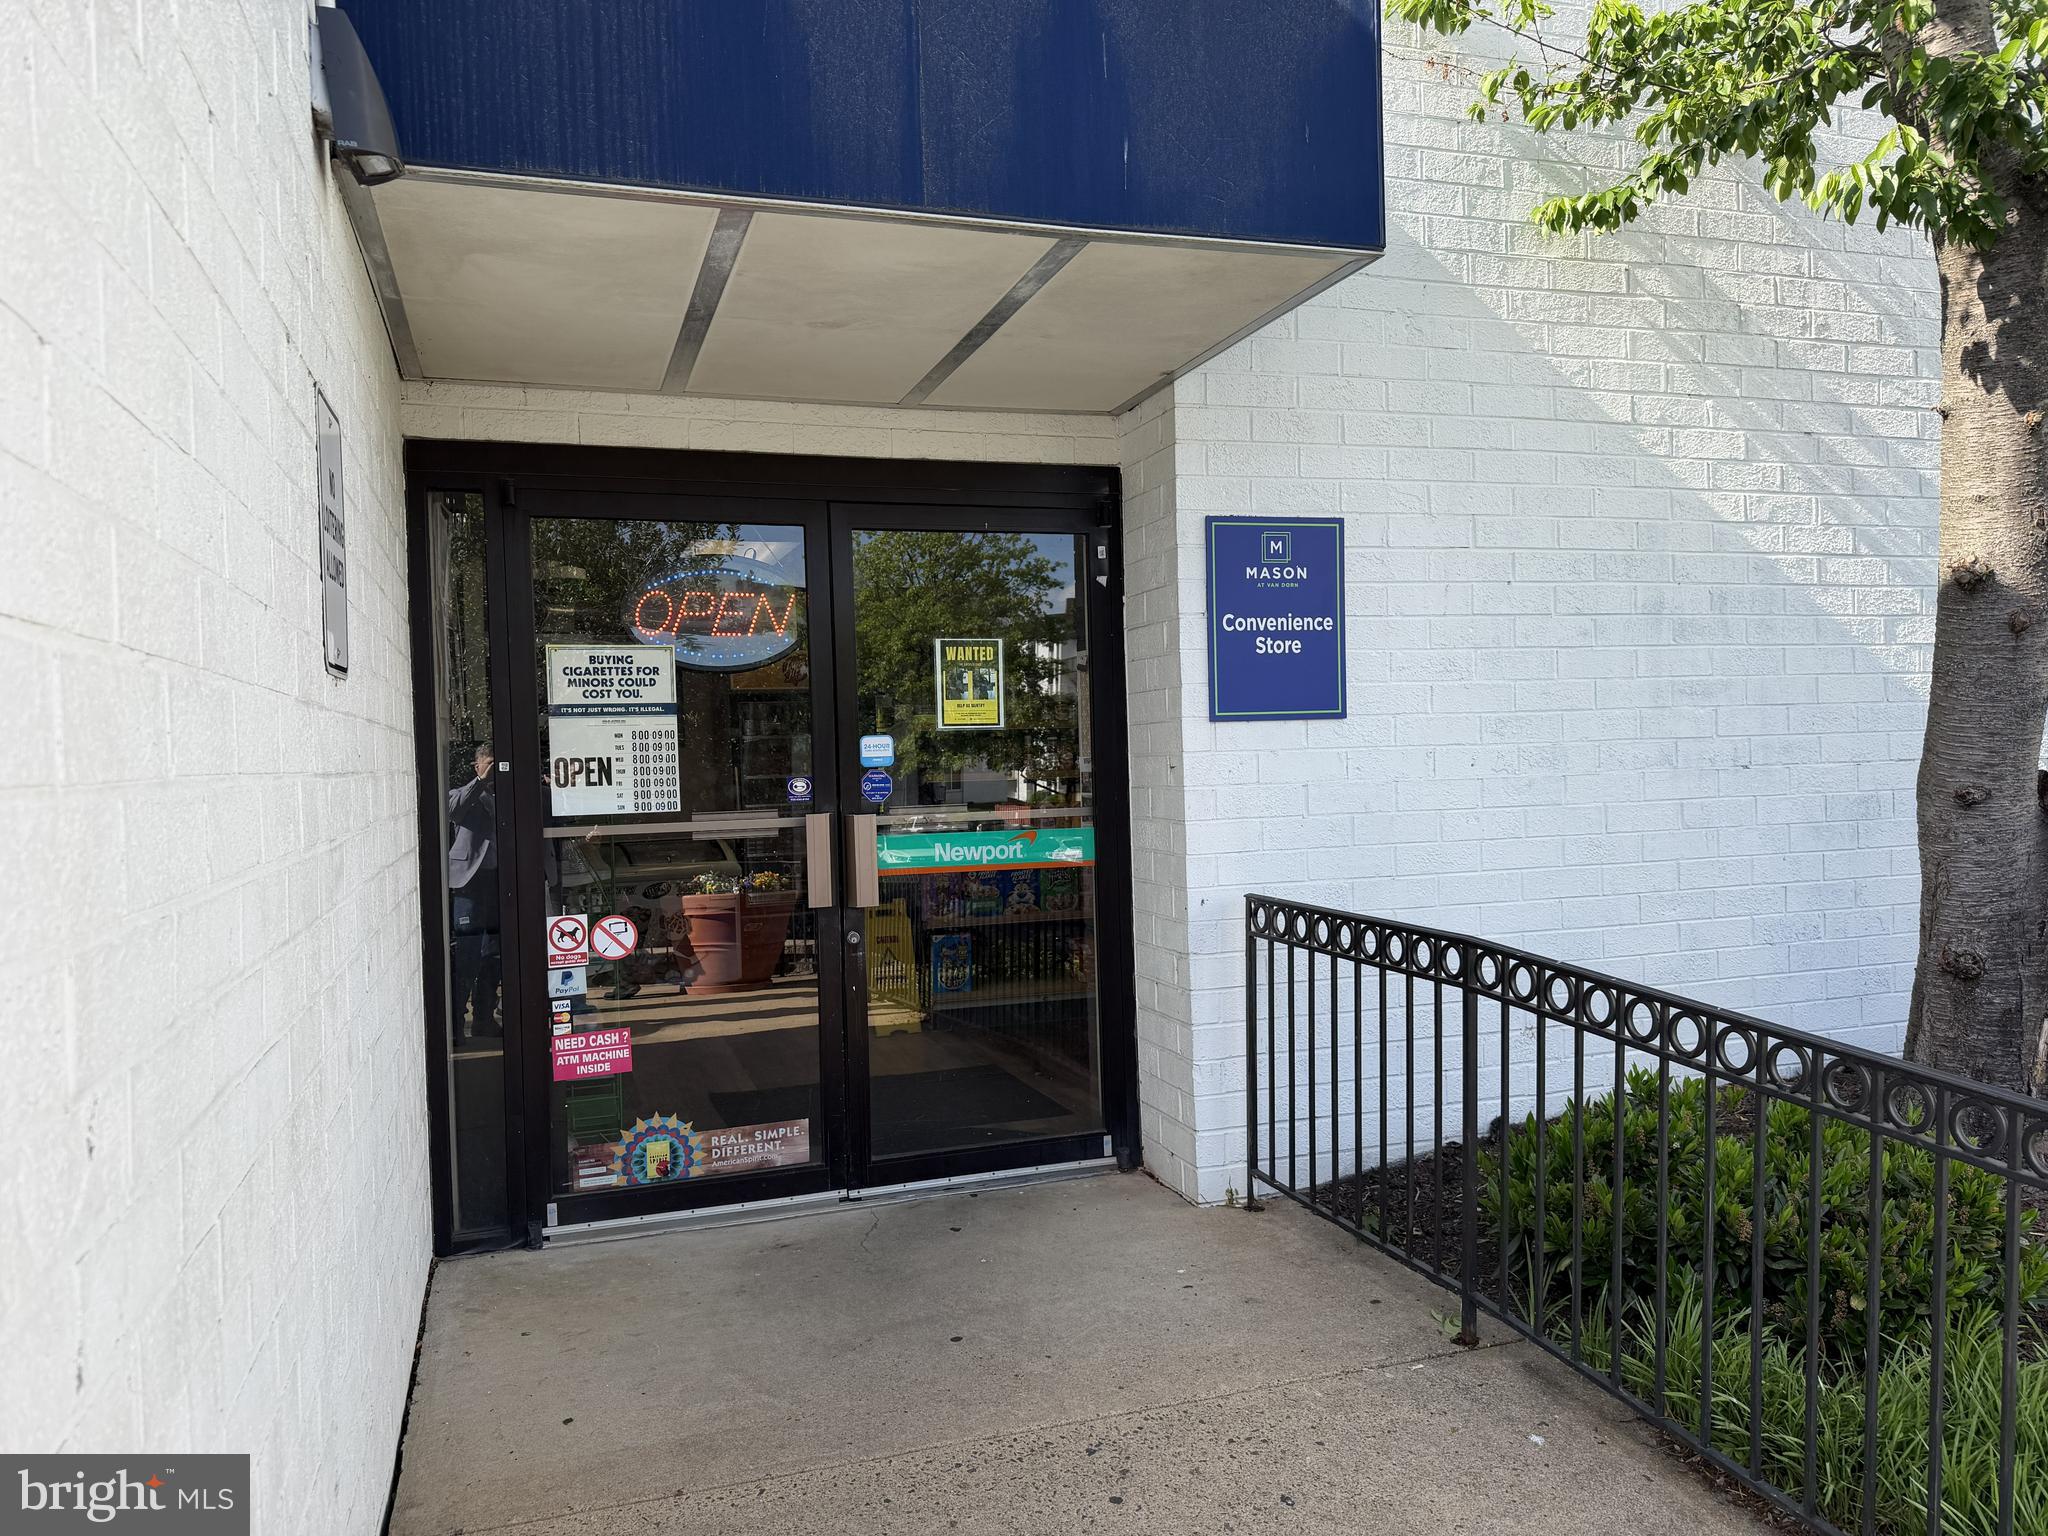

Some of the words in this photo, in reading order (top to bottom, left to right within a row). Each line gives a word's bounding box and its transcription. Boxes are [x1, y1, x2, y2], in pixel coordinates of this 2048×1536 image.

[1270, 541, 1283, 554] M
[1246, 566, 1307, 579] MASON
[634, 589, 798, 637] OPEN
[1222, 613, 1333, 632] Convenience
[1255, 636, 1302, 654] Store
[588, 655, 634, 665] BUYING
[945, 646, 994, 660] WANTED
[562, 666, 634, 676] CIGARETTES
[636, 666, 660, 676] FOR
[567, 677, 615, 688] MINORS
[618, 677, 657, 687] COULD
[582, 689, 612, 699] COST
[615, 689, 643, 699] YOU.
[554, 756, 613, 788] OPEN
[934, 840, 1024, 864] Newport
[555, 986, 580, 994] PayPal
[554, 1002, 570, 1010] VISA
[555, 1036, 586, 1051] NEED
[589, 1032, 619, 1047] CASH
[556, 1054, 580, 1066] ATM
[582, 1049, 630, 1063] MACHINE
[576, 1063, 611, 1075] INSIDE
[711, 1133, 749, 1147] REAL.
[754, 1126, 805, 1141] SIMPLE.
[711, 1140, 785, 1159] DIFFERENT.
